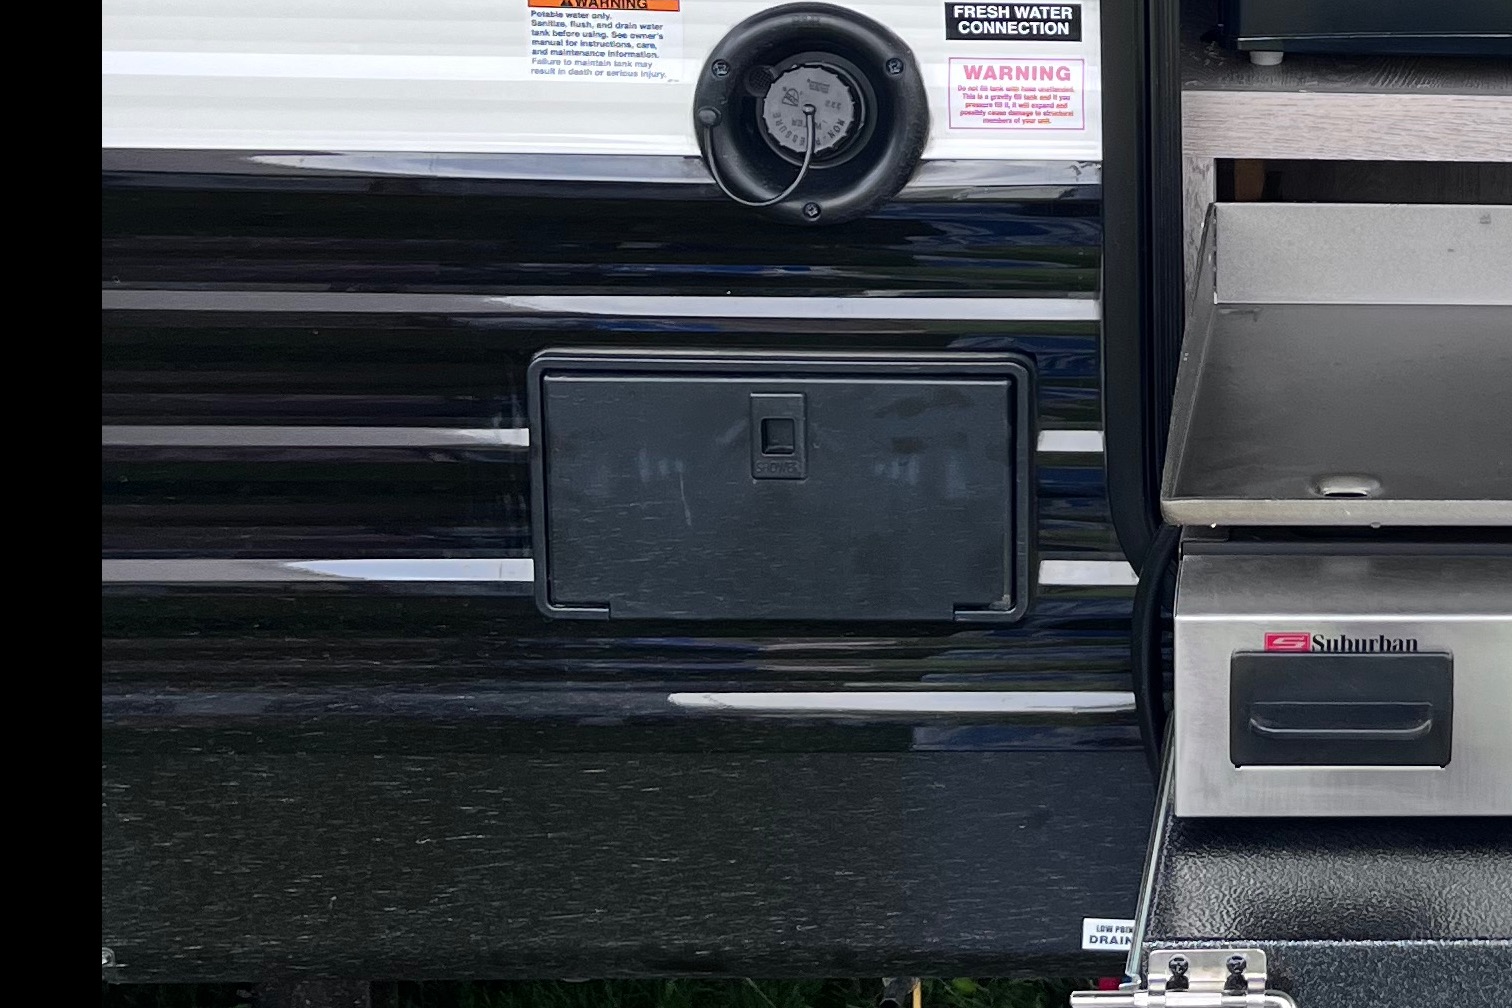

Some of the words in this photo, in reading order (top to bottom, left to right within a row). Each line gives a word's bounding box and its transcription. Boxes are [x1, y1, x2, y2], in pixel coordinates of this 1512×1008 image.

[531, 10, 563, 18] Potable
[953, 5, 1010, 19] FRESH
[1014, 6, 1073, 20] WATER
[958, 21, 1069, 35] CONNECTION
[552, 29, 580, 37] before
[611, 31, 627, 39] See
[630, 32, 663, 40] owner's
[565, 39, 578, 47] for
[550, 49, 605, 57] maintenance
[532, 57, 561, 65] Failure
[635, 61, 653, 69] may
[531, 67, 555, 75] result
[568, 68, 592, 76] death
[963, 65, 1071, 81] WARNING
[773, 112, 845, 146] NON-PESSURE
[1312, 633, 1418, 652] Suburban
[1096, 925, 1113, 933] LOW
